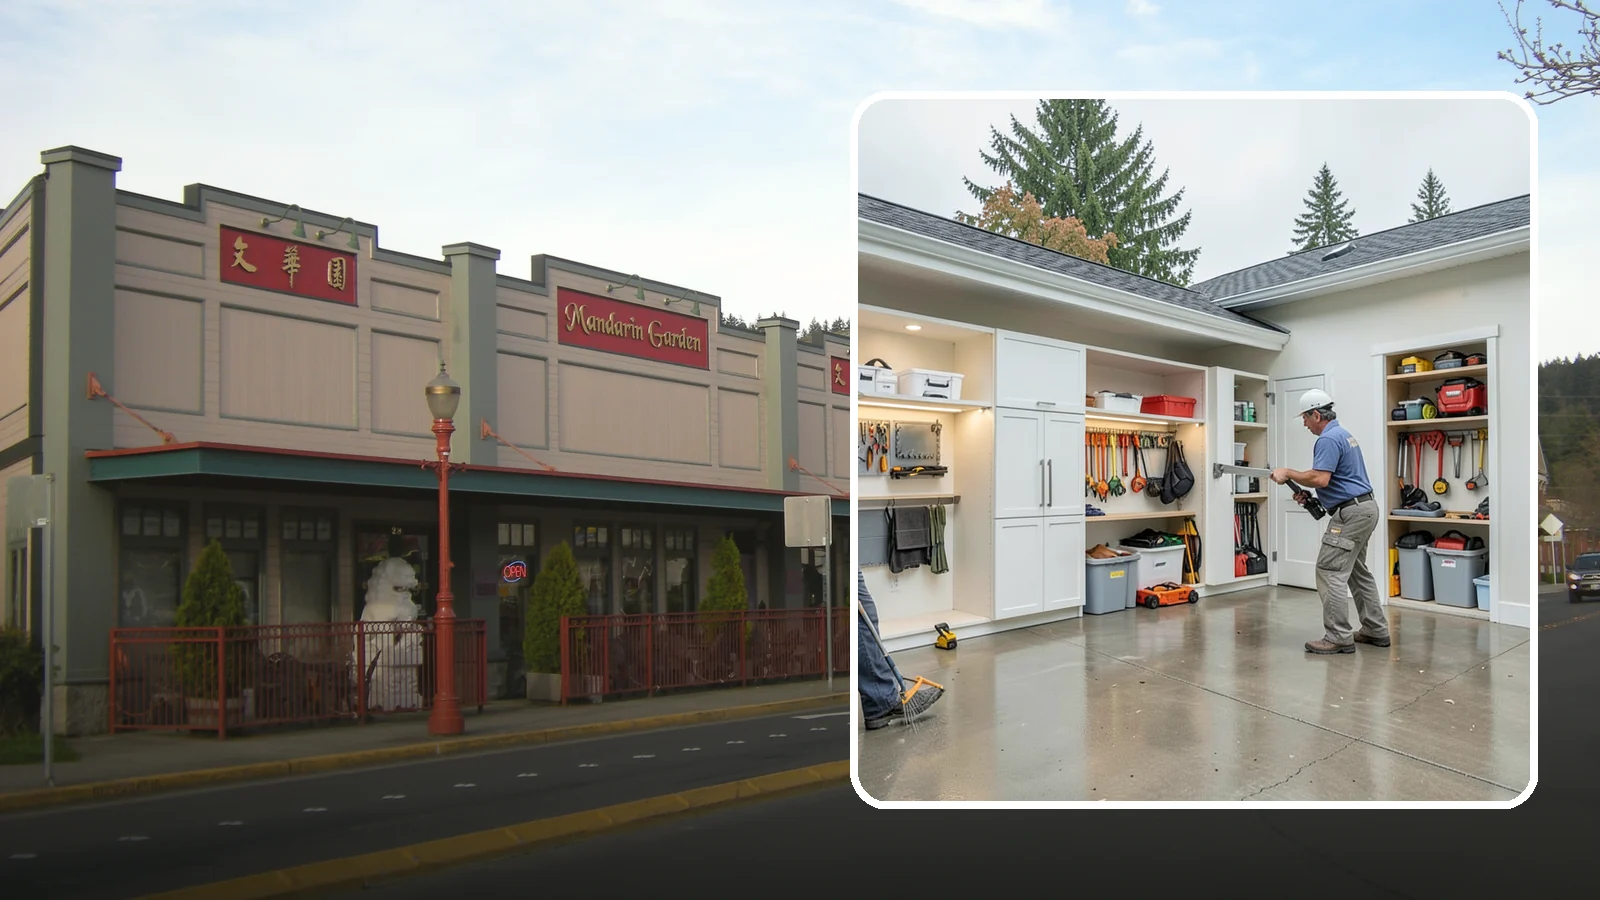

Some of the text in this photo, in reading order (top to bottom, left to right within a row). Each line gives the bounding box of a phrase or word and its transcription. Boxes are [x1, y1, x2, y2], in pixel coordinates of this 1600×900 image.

[231, 236, 346, 290] 文華園
[564, 302, 701, 352] Mandarin Garden
[503, 565, 527, 578] OPEN
